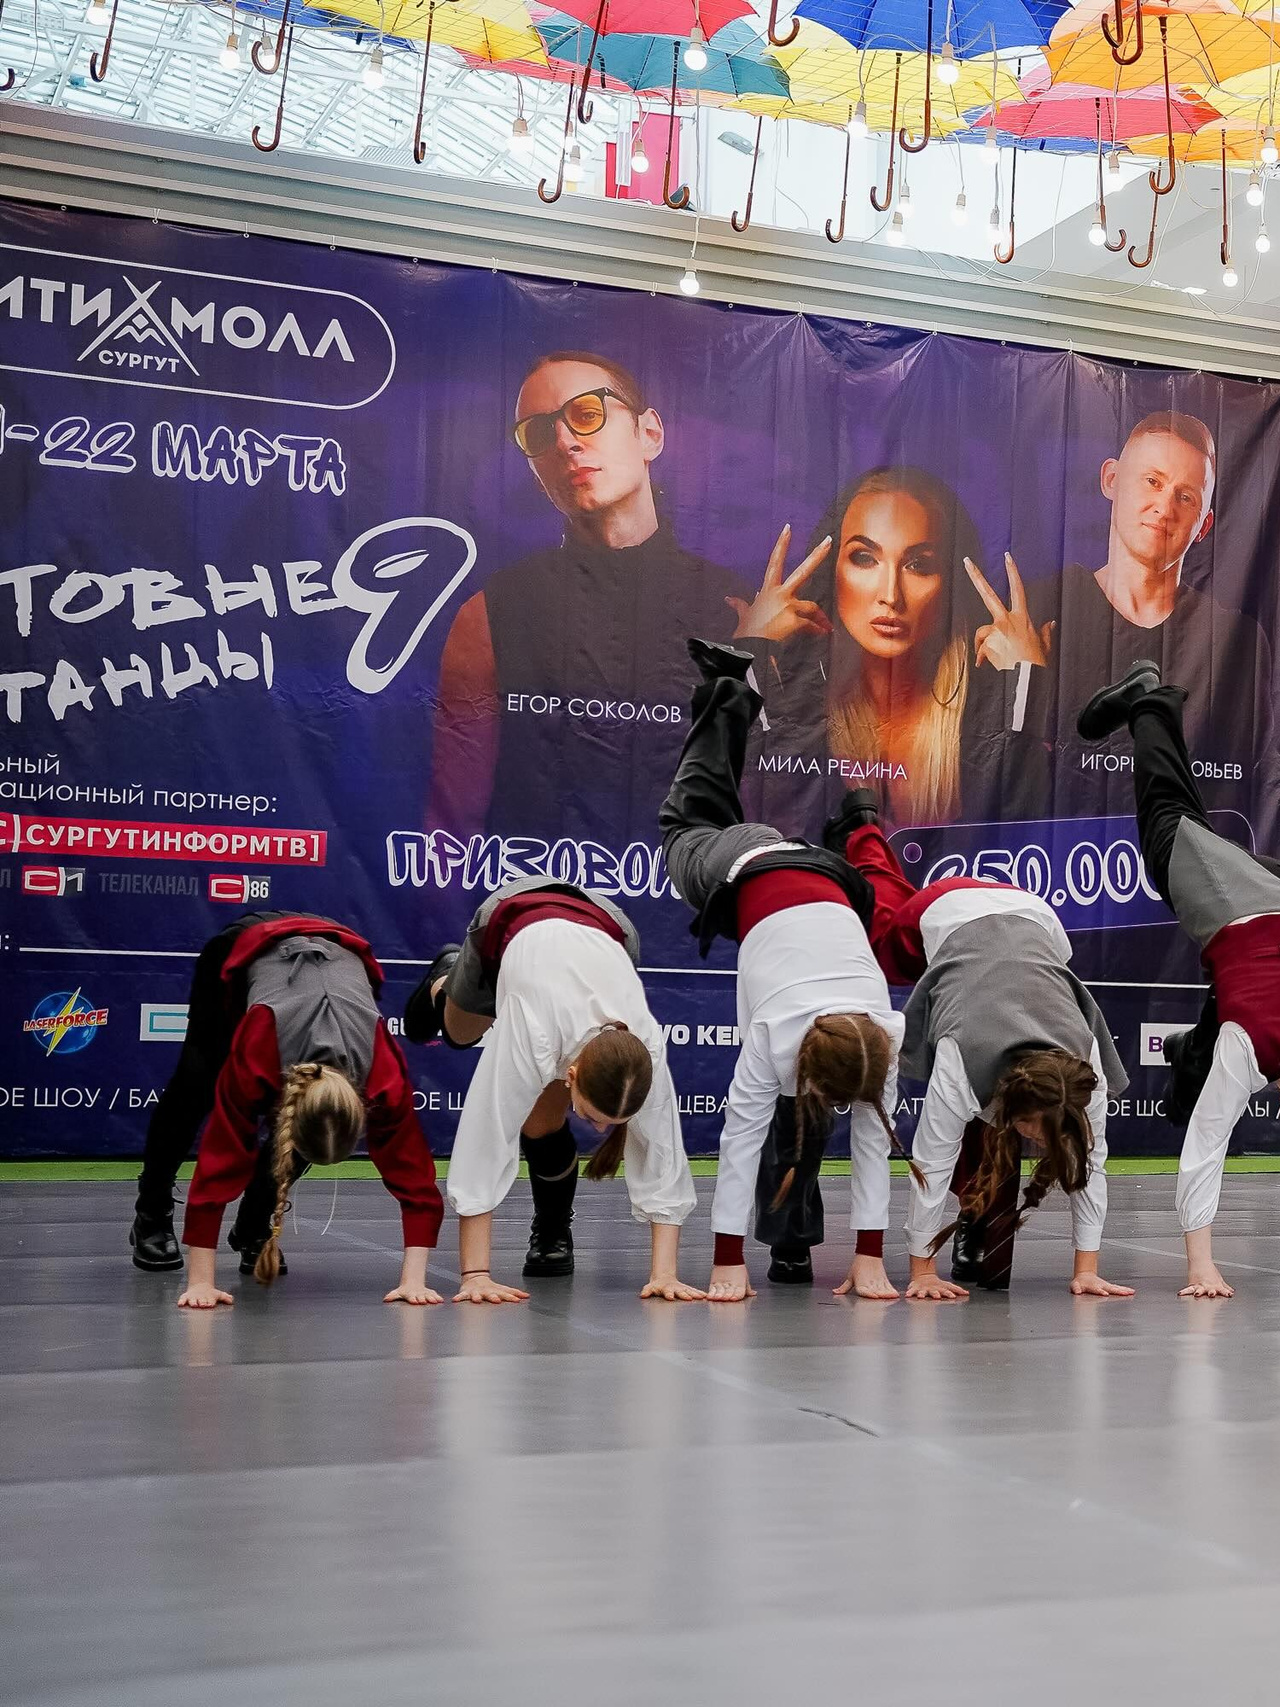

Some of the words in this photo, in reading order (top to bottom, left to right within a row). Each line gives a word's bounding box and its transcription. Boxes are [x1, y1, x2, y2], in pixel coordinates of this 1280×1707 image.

[170, 296, 356, 362] МОЛЛ
[98, 349, 180, 373] СУРГУТ
[0, 403, 137, 474] -22
[152, 421, 347, 496] МАРТА
[0, 629, 273, 724] ТАНЦЫ
[507, 693, 562, 714] ЕГОР
[568, 698, 682, 723] СОКОЛОВ
[758, 755, 822, 775] МИЛА
[828, 758, 908, 780] РЕДИНА
[1081, 753, 1134, 772] ИГОР
[0, 781, 144, 806] ационный
[153, 789, 278, 817] партнер:
[99, 873, 199, 897] ТЕЛЕКАНАЛ
[23, 1008, 109, 1031] LASERFORCE
[34, 1088, 101, 1108] ШОУ
[129, 1088, 165, 1108] БА
